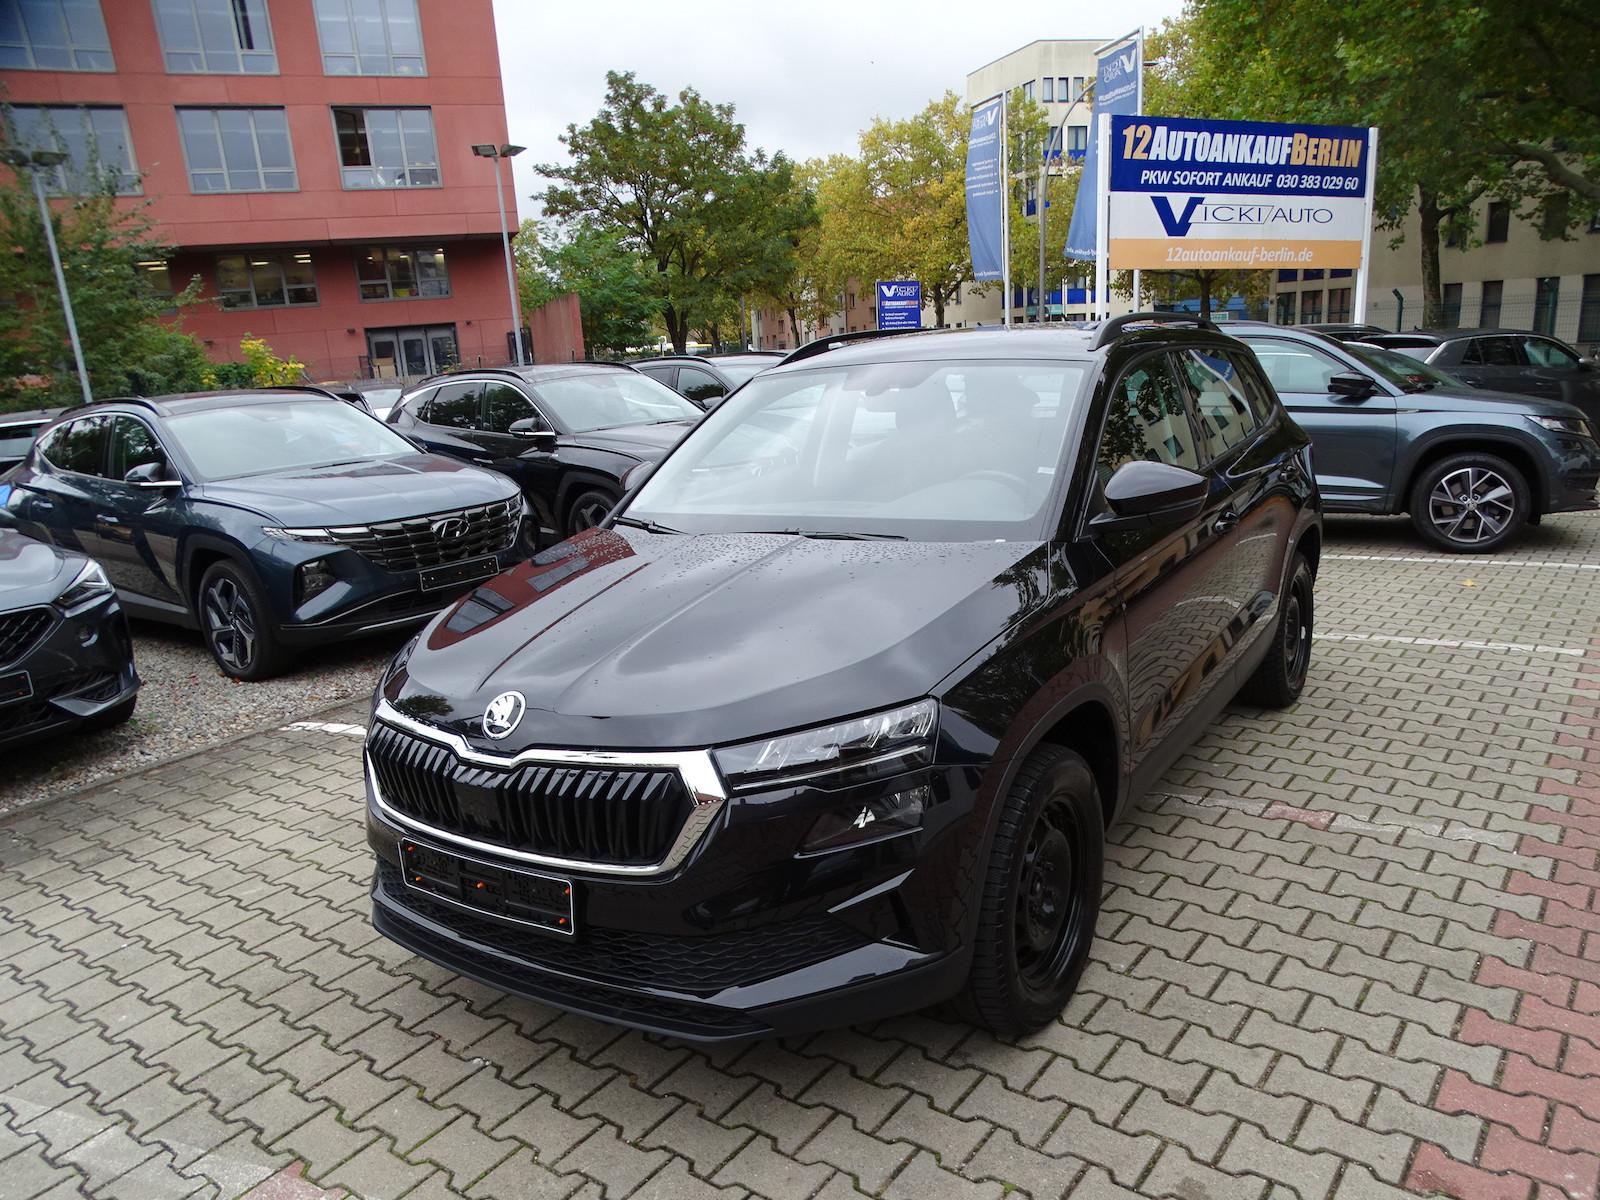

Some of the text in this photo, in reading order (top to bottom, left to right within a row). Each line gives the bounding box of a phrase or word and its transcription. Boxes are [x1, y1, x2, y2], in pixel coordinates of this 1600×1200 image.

[1122, 124, 1362, 168] 12AUTOANKAUFBERLIN
[1140, 169, 1359, 190] PKW SOFORT ANKAUF 030 383 029 60
[1150, 195, 1333, 237] VICKI AUTO
[1166, 247, 1314, 265] 12autoankauf-berlin.de
